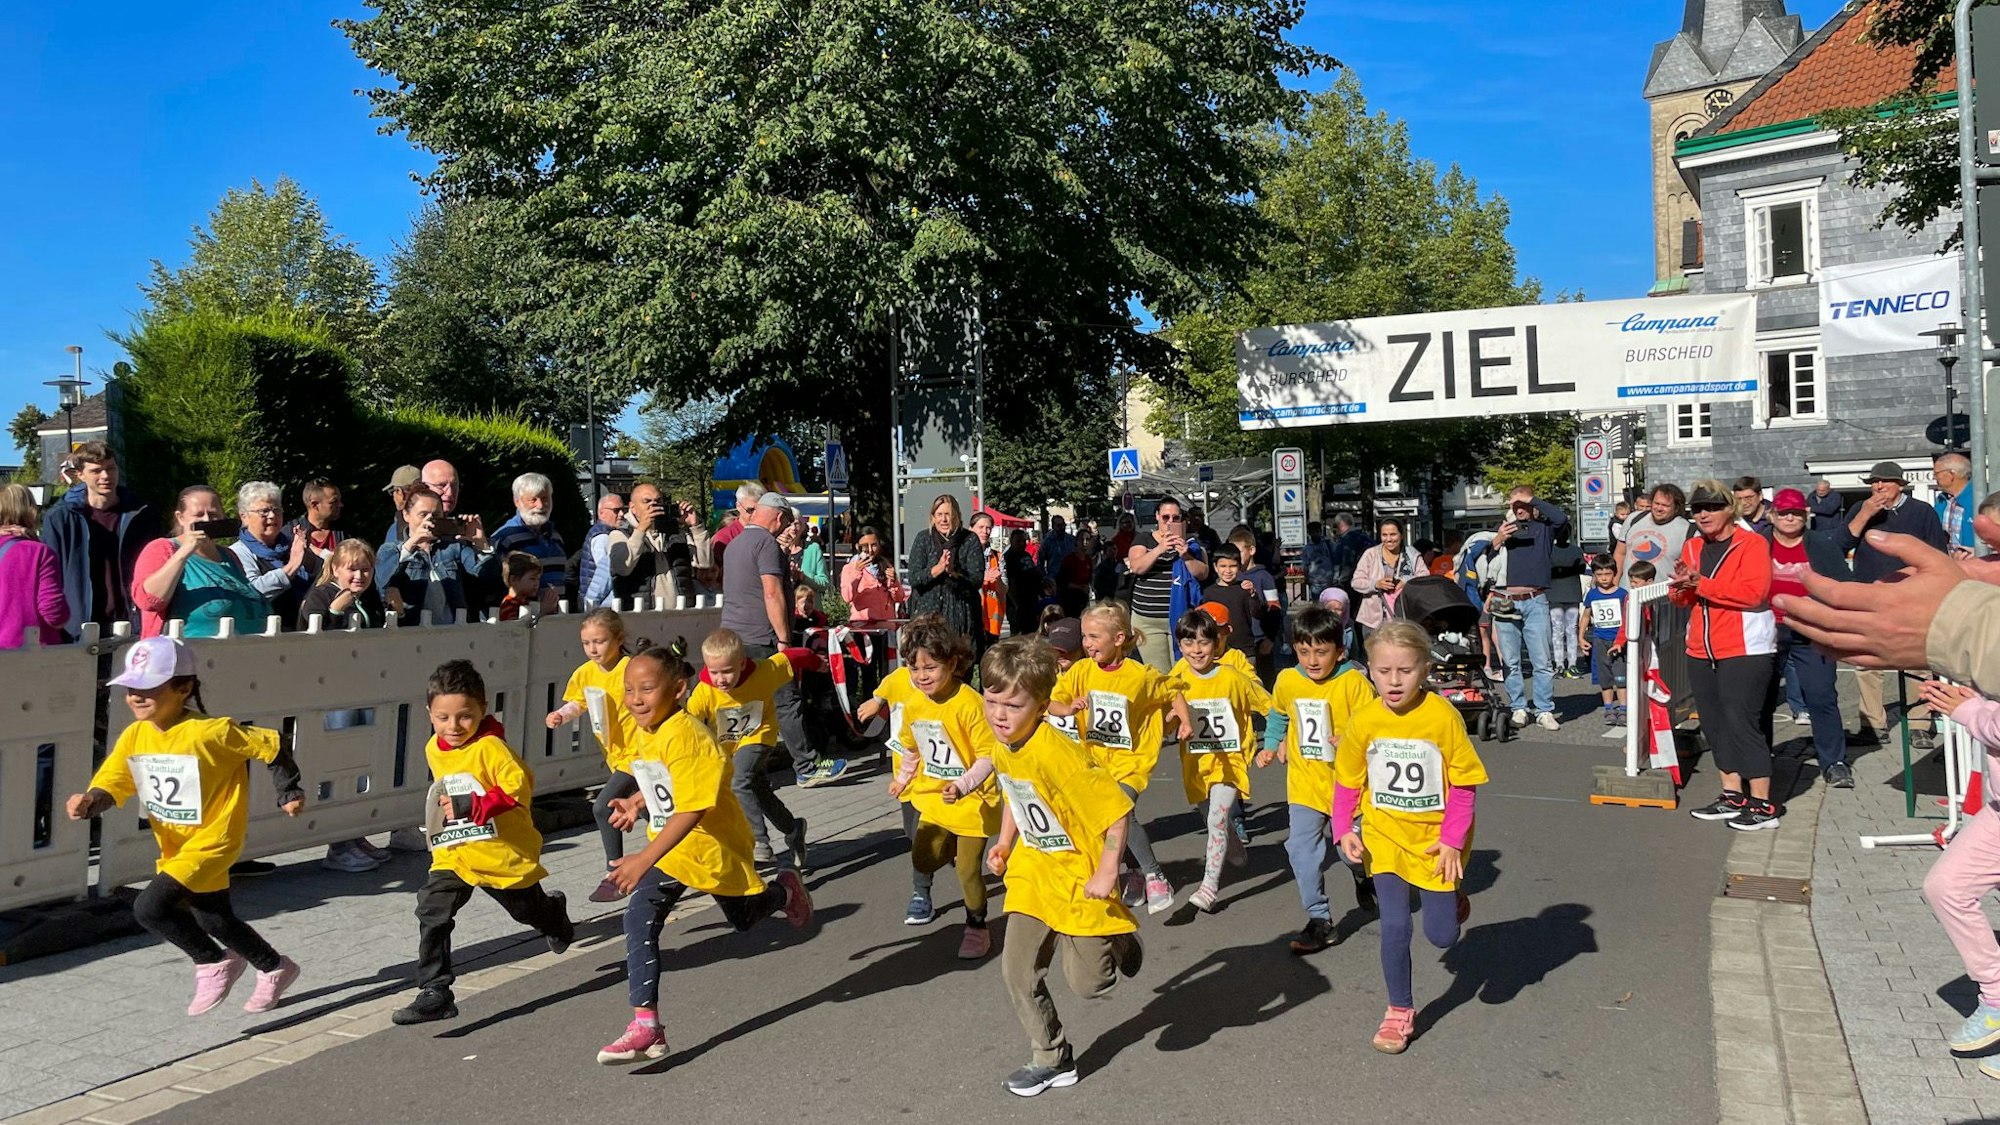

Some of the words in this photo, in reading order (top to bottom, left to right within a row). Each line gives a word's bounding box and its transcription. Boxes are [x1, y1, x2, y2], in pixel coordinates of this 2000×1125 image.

[1829, 290, 1950, 320] TENNECO
[1619, 312, 1720, 334] Campana
[1266, 339, 1356, 358] Campana
[1625, 345, 1713, 362] BURSCHEID
[1387, 325, 1576, 403] ZIEL
[1269, 368, 1348, 387] BURSCHEID
[1284, 458, 1293, 468] 20
[1588, 446, 1600, 455] 20
[1599, 608, 1614, 621] 39
[1095, 707, 1123, 733] 28
[1197, 715, 1226, 739] 25
[928, 738, 951, 765] 27
[149, 774, 183, 806] 32
[1386, 761, 1425, 794] 29
[654, 783, 675, 813] 9
[1019, 801, 1050, 833] 0
